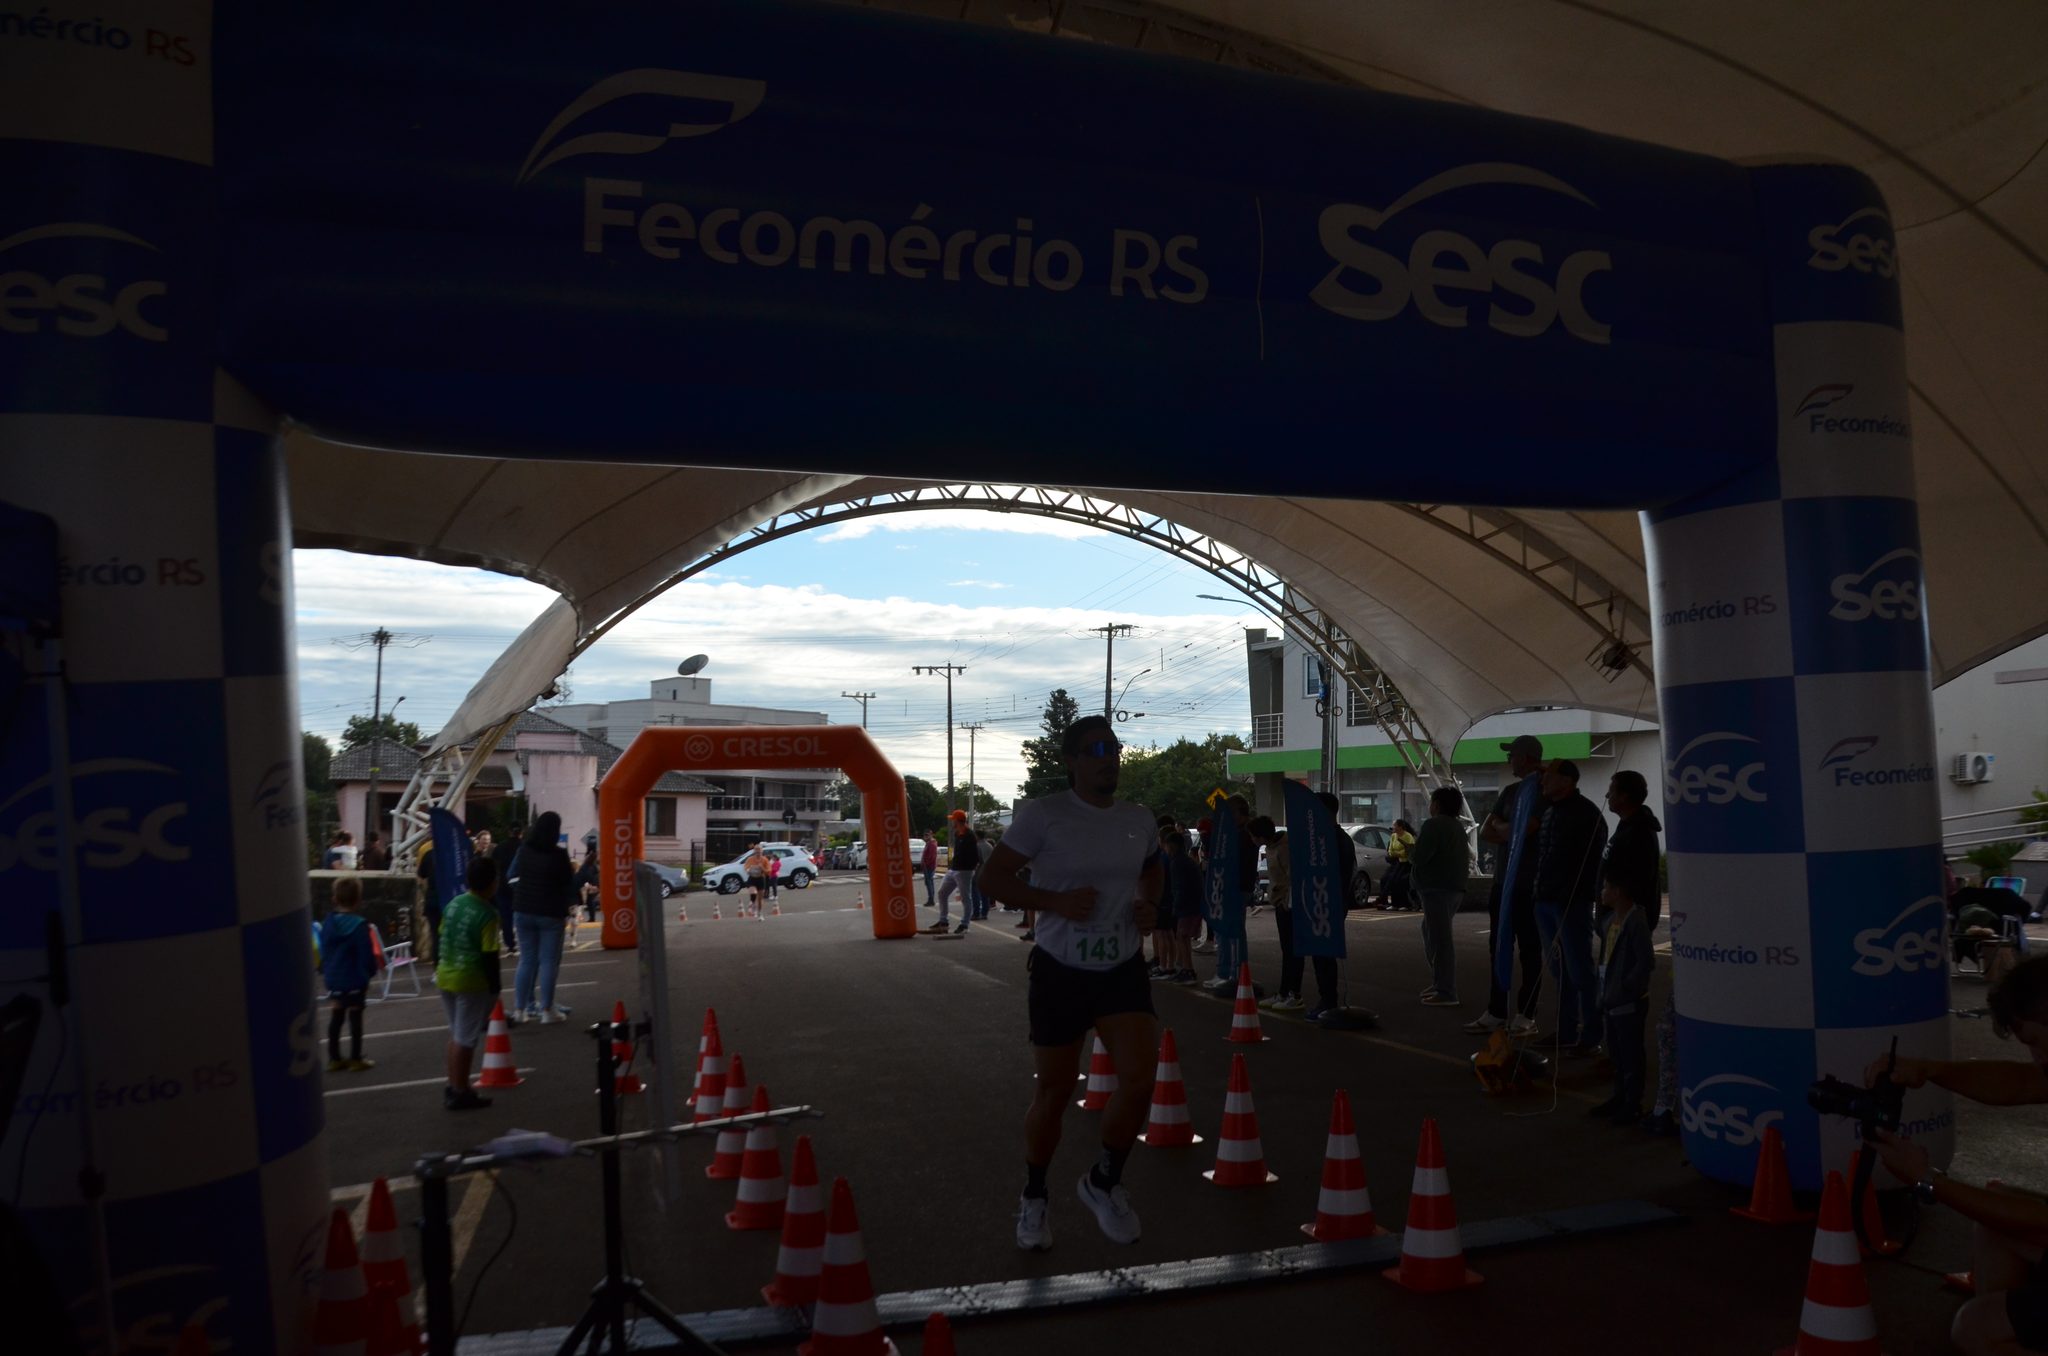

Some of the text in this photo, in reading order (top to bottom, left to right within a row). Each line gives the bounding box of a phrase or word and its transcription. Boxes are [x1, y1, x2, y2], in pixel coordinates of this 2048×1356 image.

[146, 28, 195, 66] RS
[583, 177, 1209, 304] Fecomércio RS
[1308, 202, 1612, 345] Sesc
[158, 557, 206, 587] RS
[1743, 594, 1777, 616] RS
[722, 735, 829, 759] CRESOL
[614, 811, 633, 901] CRESOL
[884, 803, 905, 889] CRESOL
[1311, 875, 1331, 938] Sesc
[1076, 936, 1120, 962] 143
[1765, 945, 1800, 967] RS
